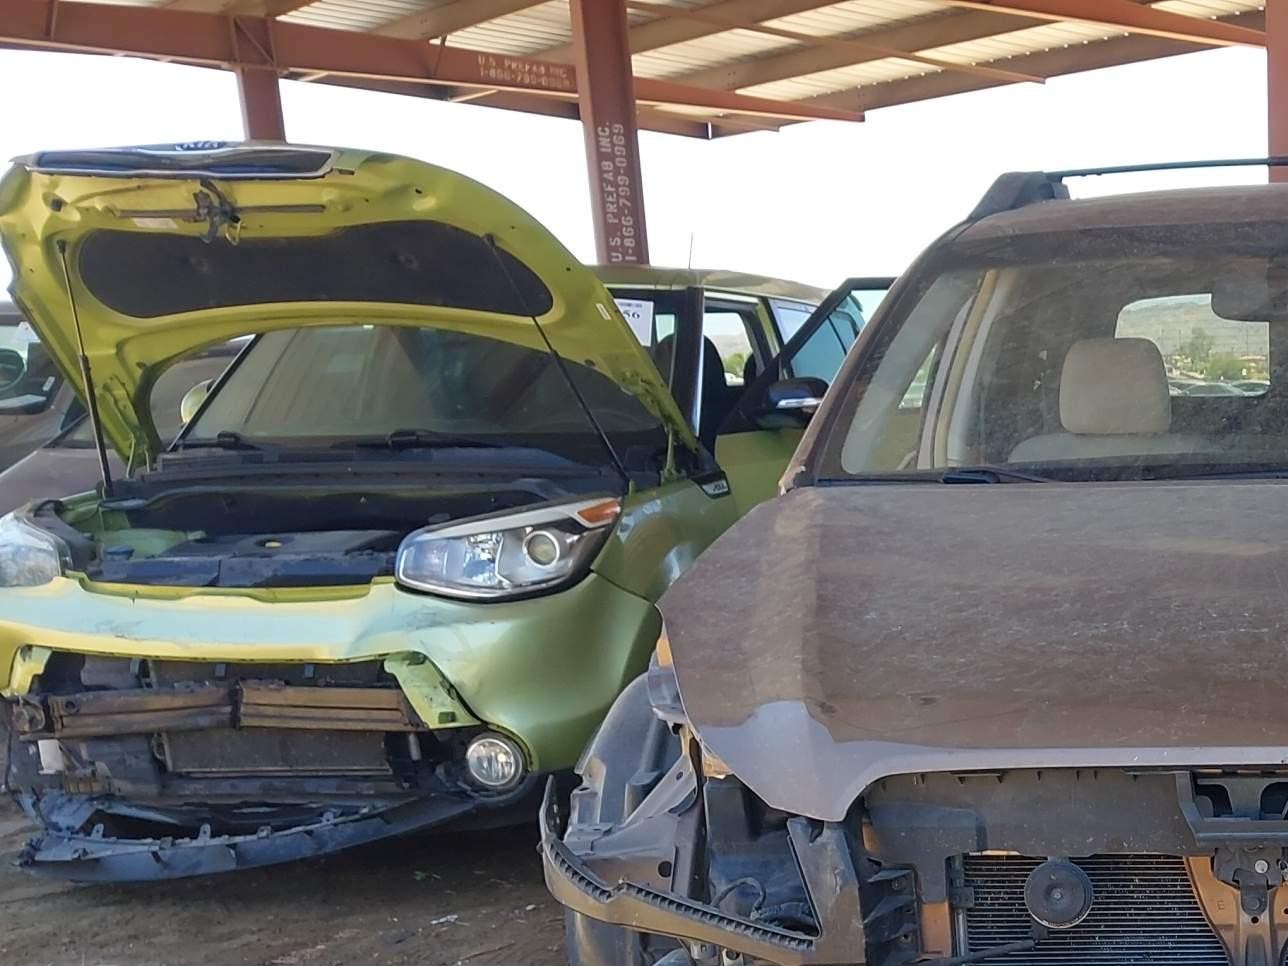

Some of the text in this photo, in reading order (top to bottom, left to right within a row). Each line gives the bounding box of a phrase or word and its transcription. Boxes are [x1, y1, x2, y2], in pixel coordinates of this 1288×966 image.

[597, 122, 623, 262] U.S. PREFAB INC.
[612, 123, 638, 262] 1-866-799-0969
